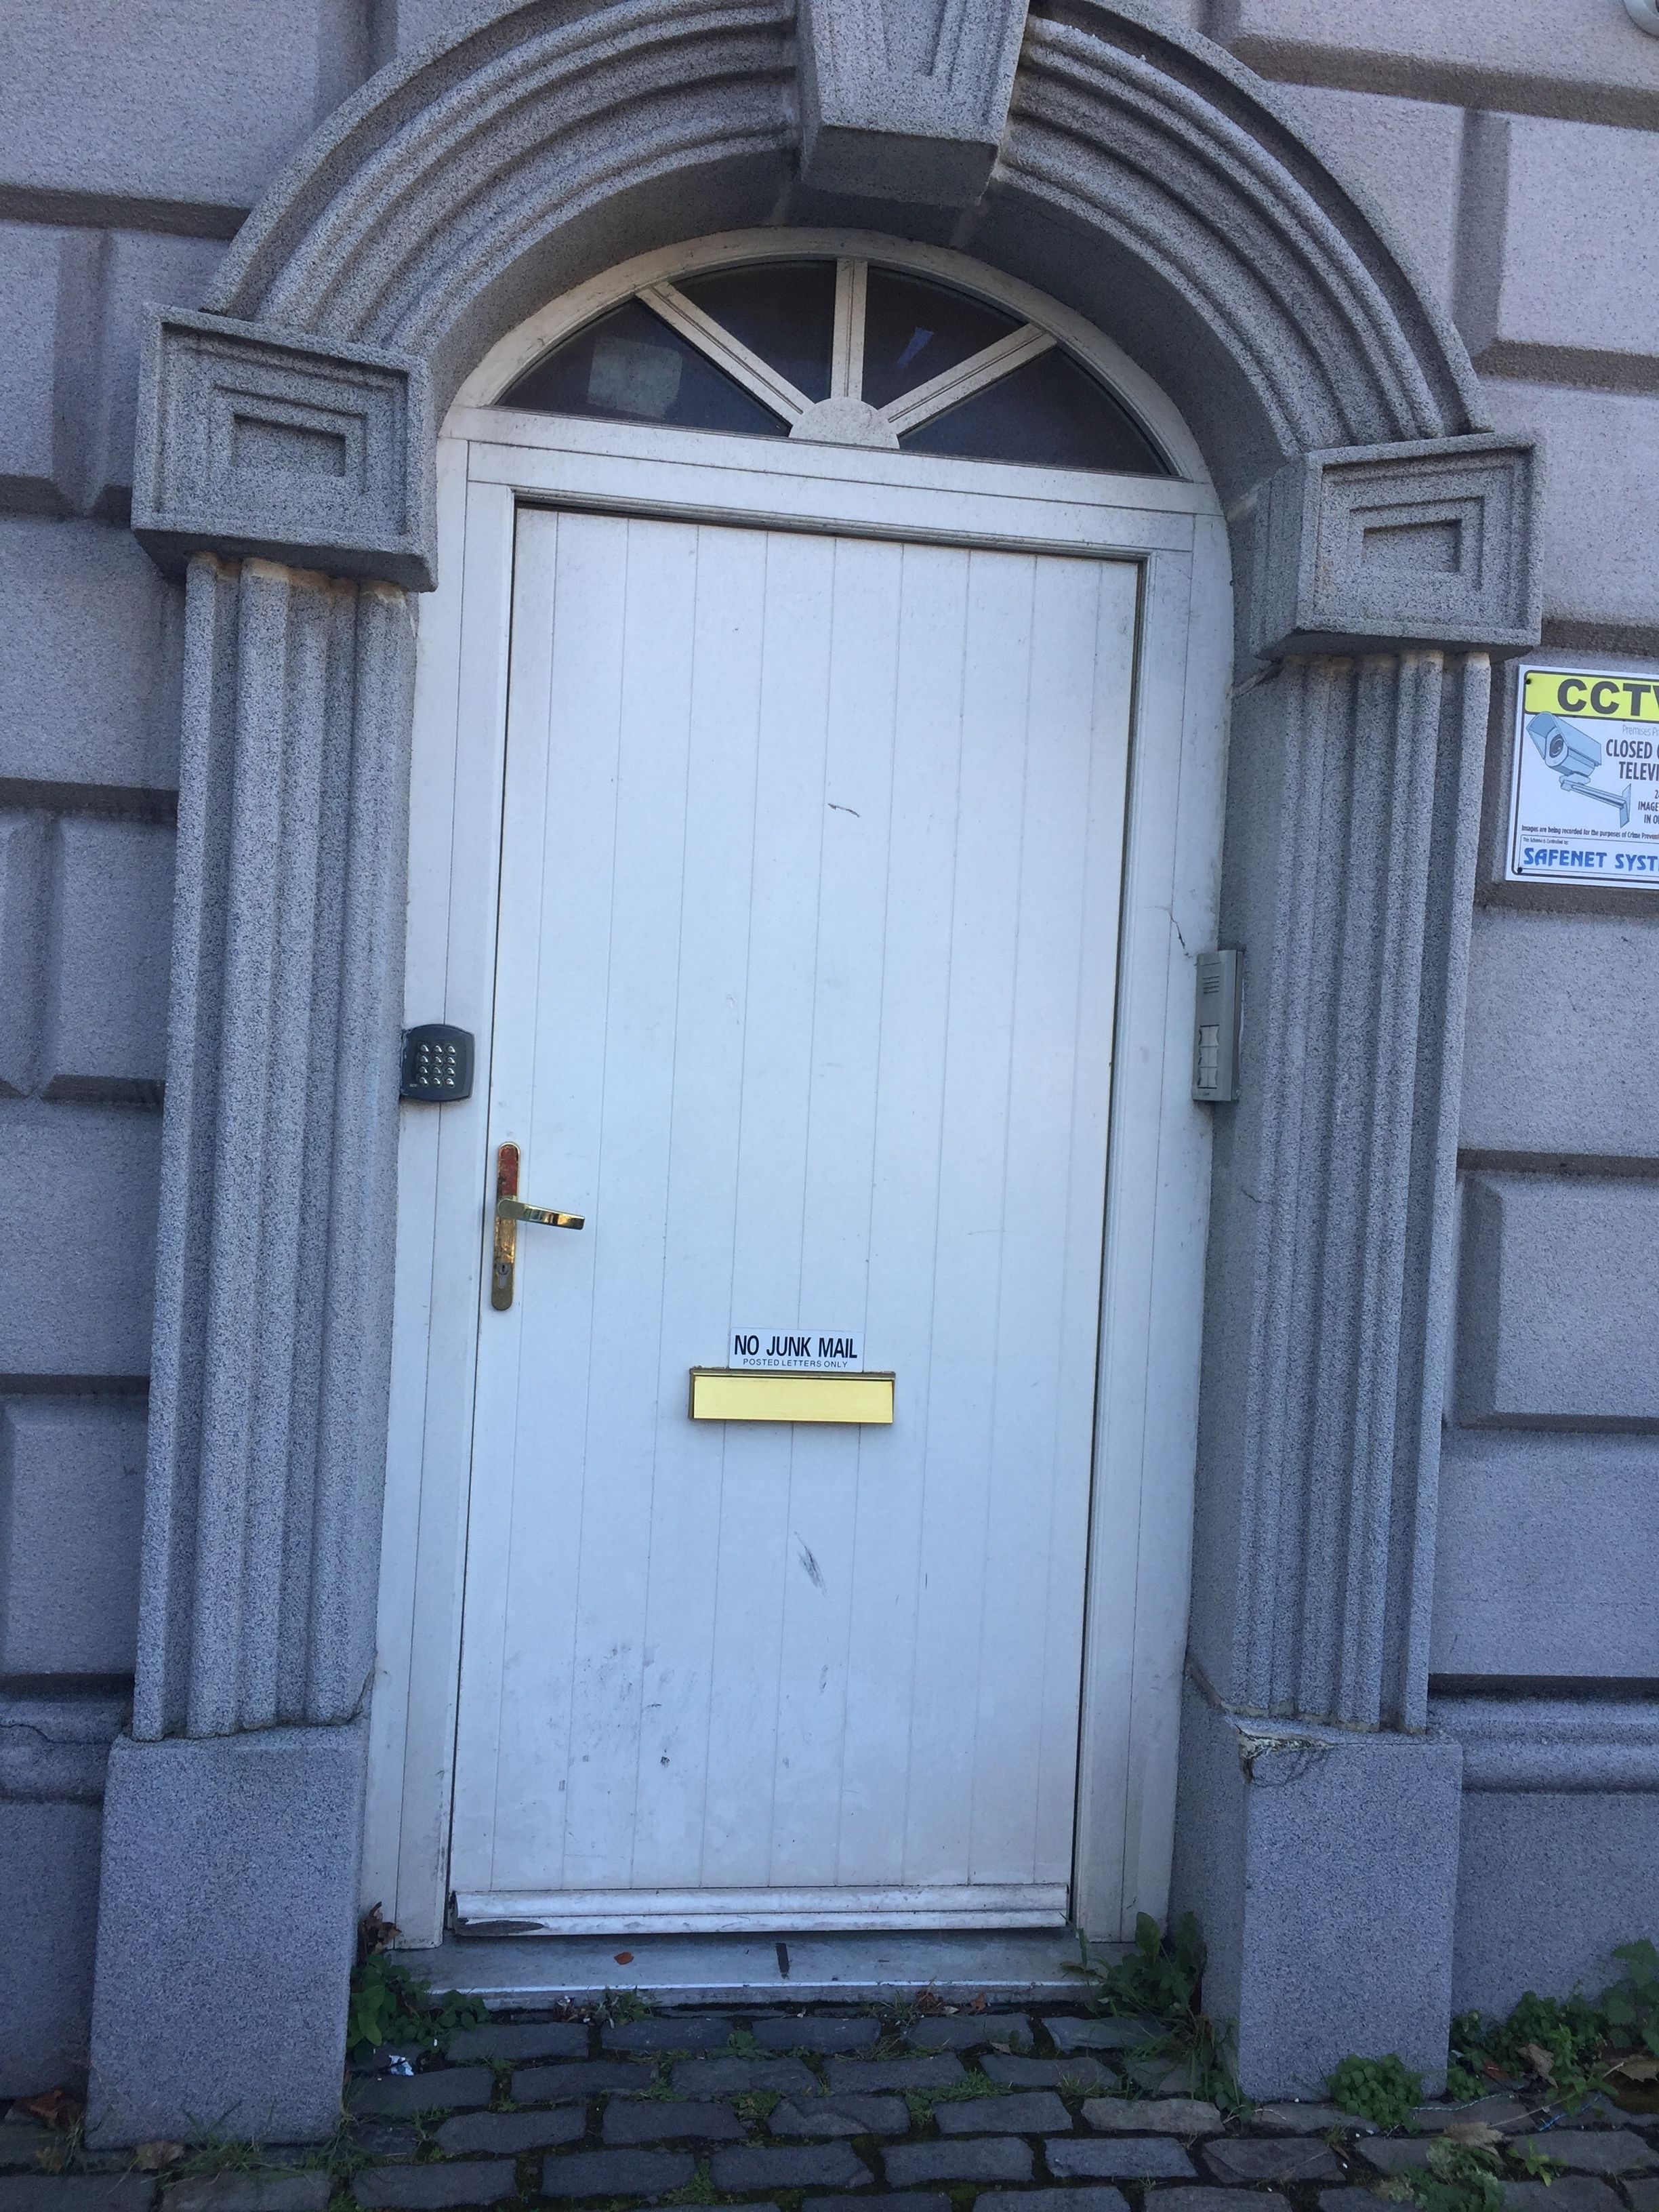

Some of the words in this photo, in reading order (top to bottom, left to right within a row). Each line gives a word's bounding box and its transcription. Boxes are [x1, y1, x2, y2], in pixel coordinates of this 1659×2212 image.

[1557, 678, 1659, 716] CCT
[1622, 724, 1652, 737] Premises
[1605, 739, 1653, 759] CLOSED
[1643, 814, 1652, 824] IN
[1521, 825, 1538, 833] Images
[1548, 827, 1561, 835] being
[1523, 848, 1607, 868] SAFENET
[1614, 853, 1659, 872] SYST
[735, 1335, 759, 1355] NO
[766, 1336, 812, 1357] JUNK
[818, 1338, 858, 1358] MAIL
[743, 1358, 779, 1366] POSTED
[781, 1359, 821, 1368] LETTERS
